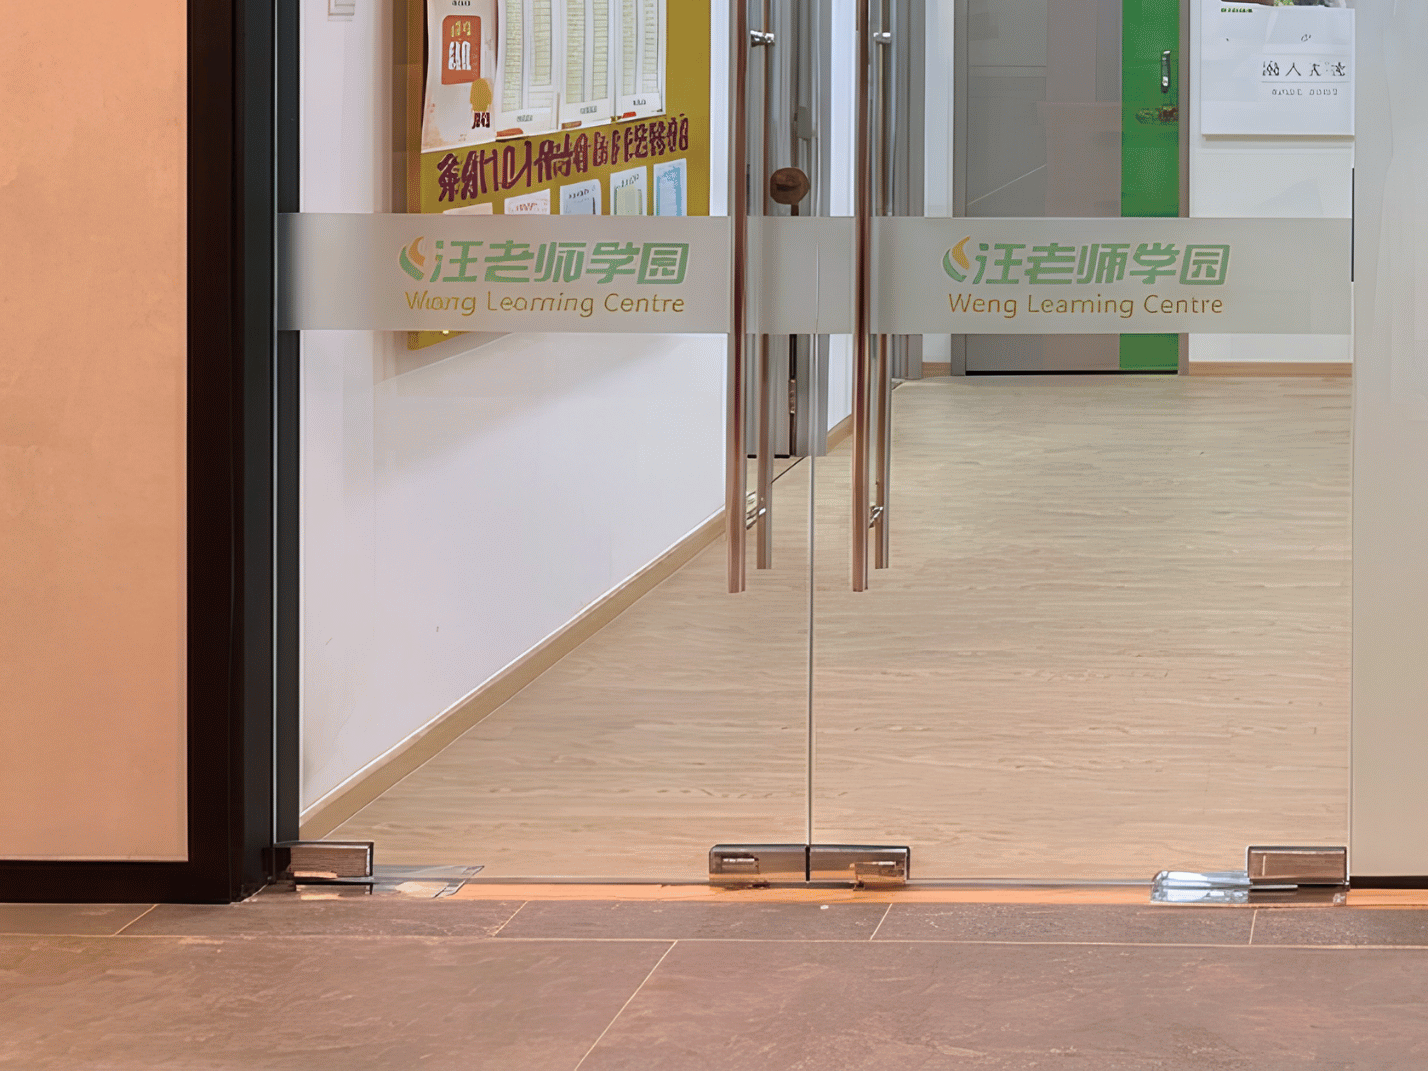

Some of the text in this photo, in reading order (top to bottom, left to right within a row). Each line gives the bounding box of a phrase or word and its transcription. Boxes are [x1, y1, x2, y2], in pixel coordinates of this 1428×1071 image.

[429, 240, 690, 284] 汪老师学园
[972, 242, 1231, 285] 汪老师学园
[487, 291, 594, 317] Learning
[604, 293, 685, 312] Centre
[1028, 294, 1134, 318] Learning
[1143, 294, 1223, 314] Centre
